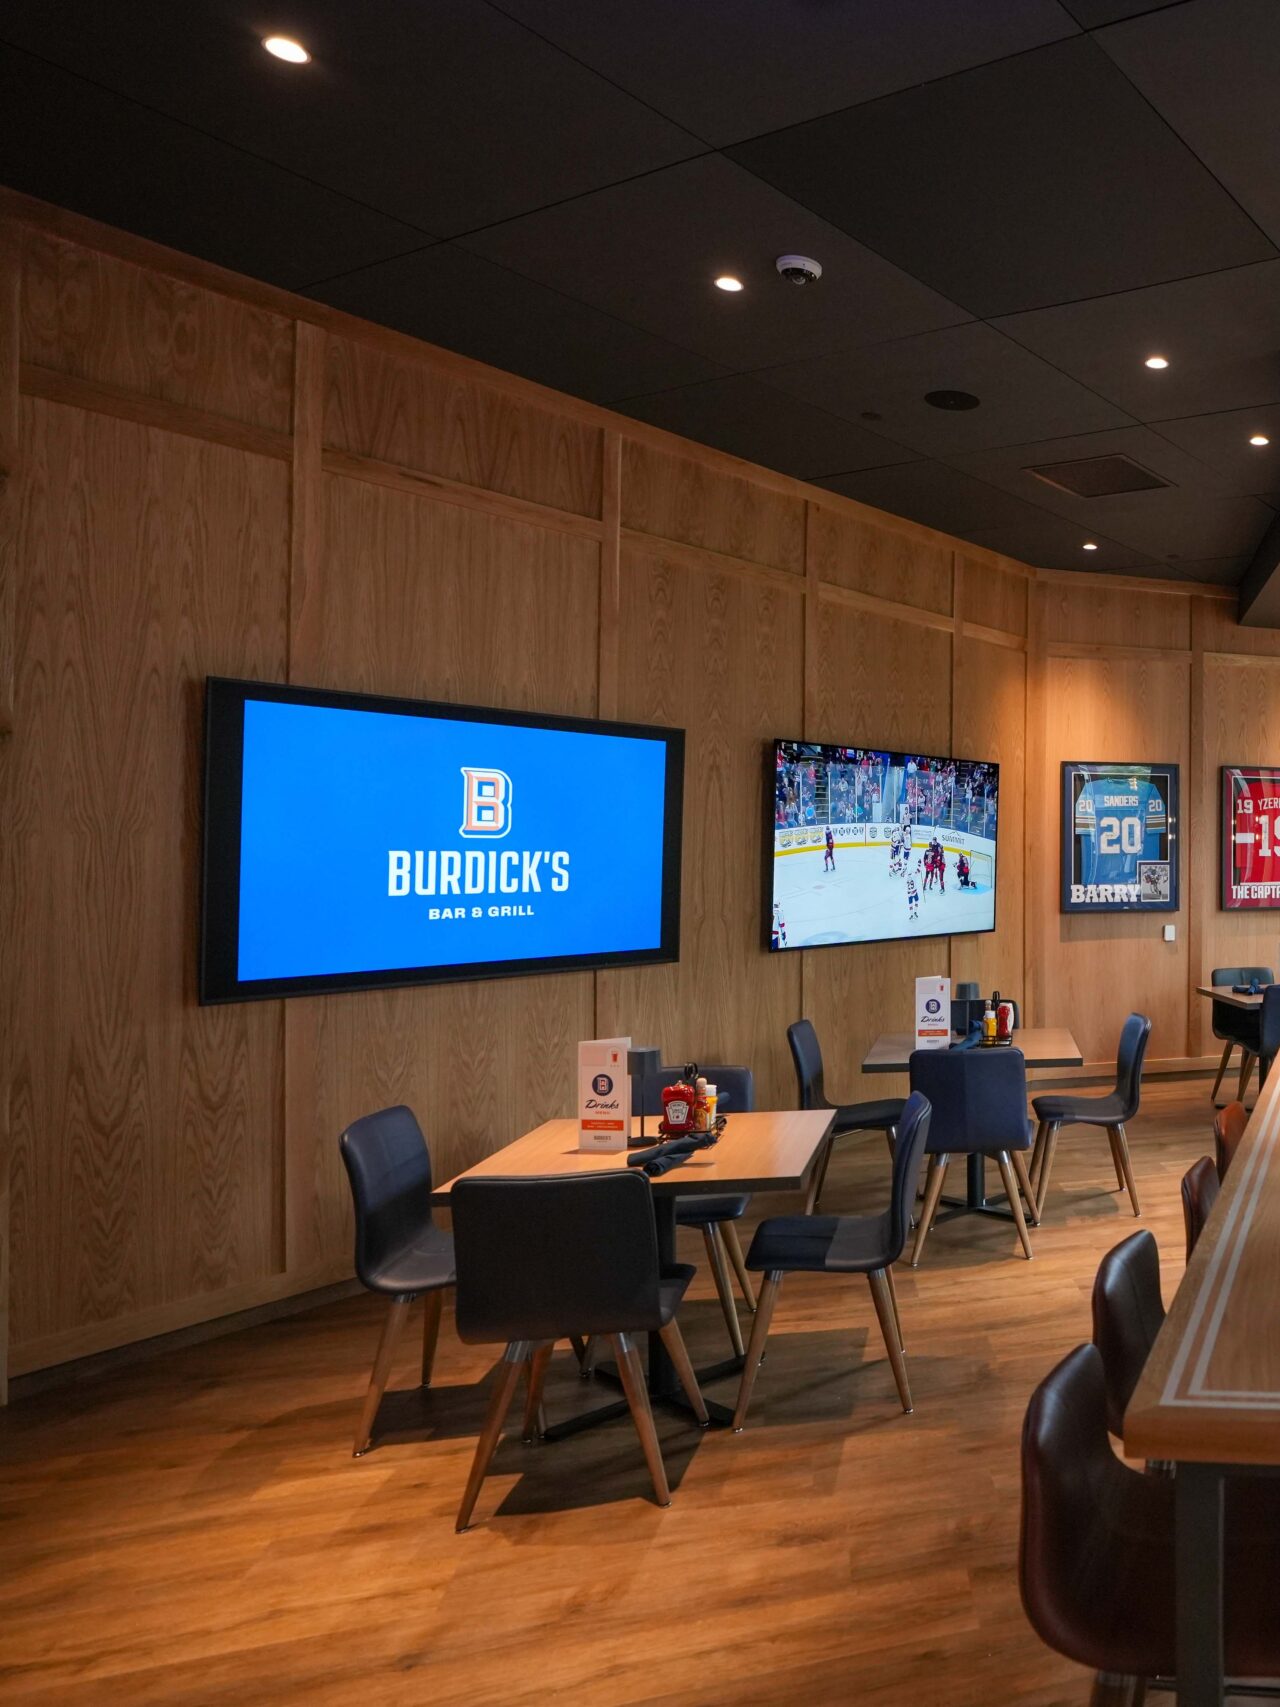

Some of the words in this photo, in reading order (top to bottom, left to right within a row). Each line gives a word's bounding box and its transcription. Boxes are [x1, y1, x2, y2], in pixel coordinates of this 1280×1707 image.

[459, 767, 513, 839] B
[1078, 799, 1093, 812] 20
[1103, 795, 1139, 807] SANDERS
[1148, 799, 1163, 812] 20
[1236, 799, 1254, 814] 19
[1100, 816, 1142, 854] 20
[388, 850, 570, 897] BURDICK'S
[1070, 884, 1141, 903] BARRY
[1232, 885, 1249, 899] THE
[428, 907, 466, 920] BAR
[471, 907, 483, 918] &
[488, 905, 534, 917] GRILL
[585, 1099, 620, 1109] Drinks
